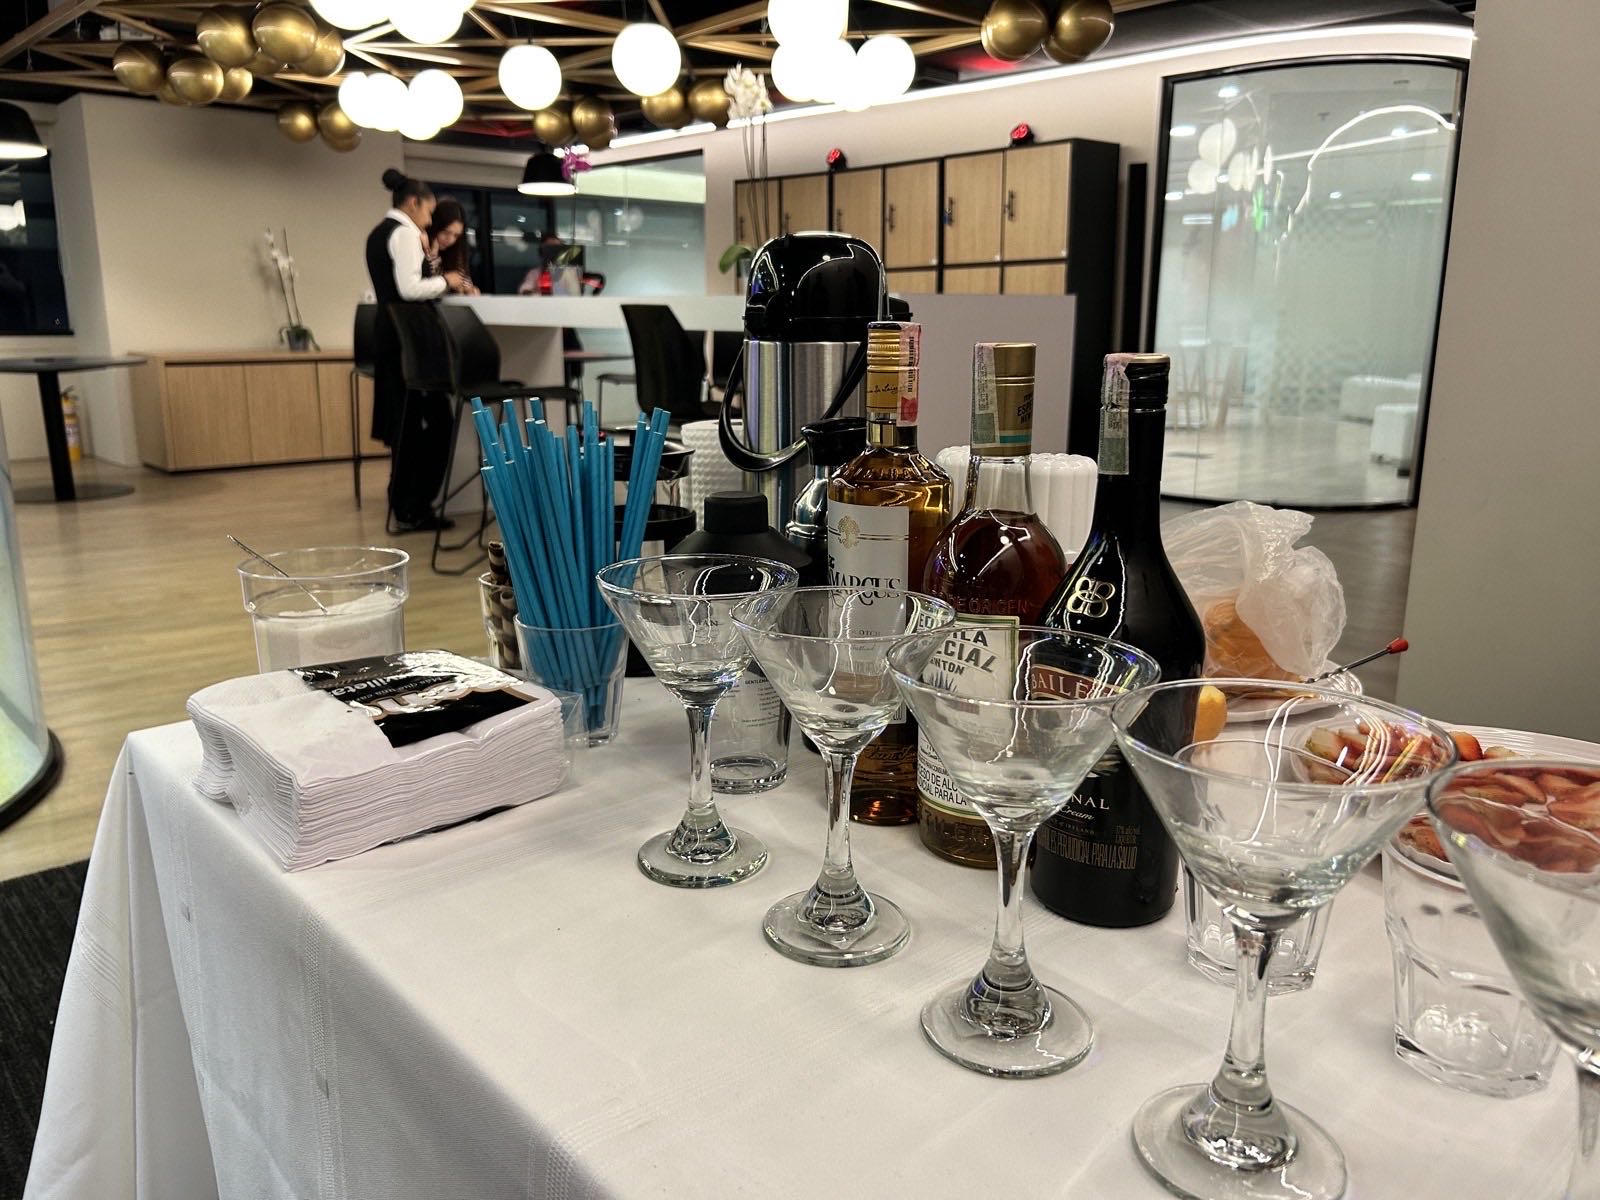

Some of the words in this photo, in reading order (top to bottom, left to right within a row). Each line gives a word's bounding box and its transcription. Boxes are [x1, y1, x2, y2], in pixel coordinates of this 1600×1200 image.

[936, 640, 997, 673] CIAL
[934, 786, 955, 803] PARA
[1060, 804, 1095, 821] Cream
